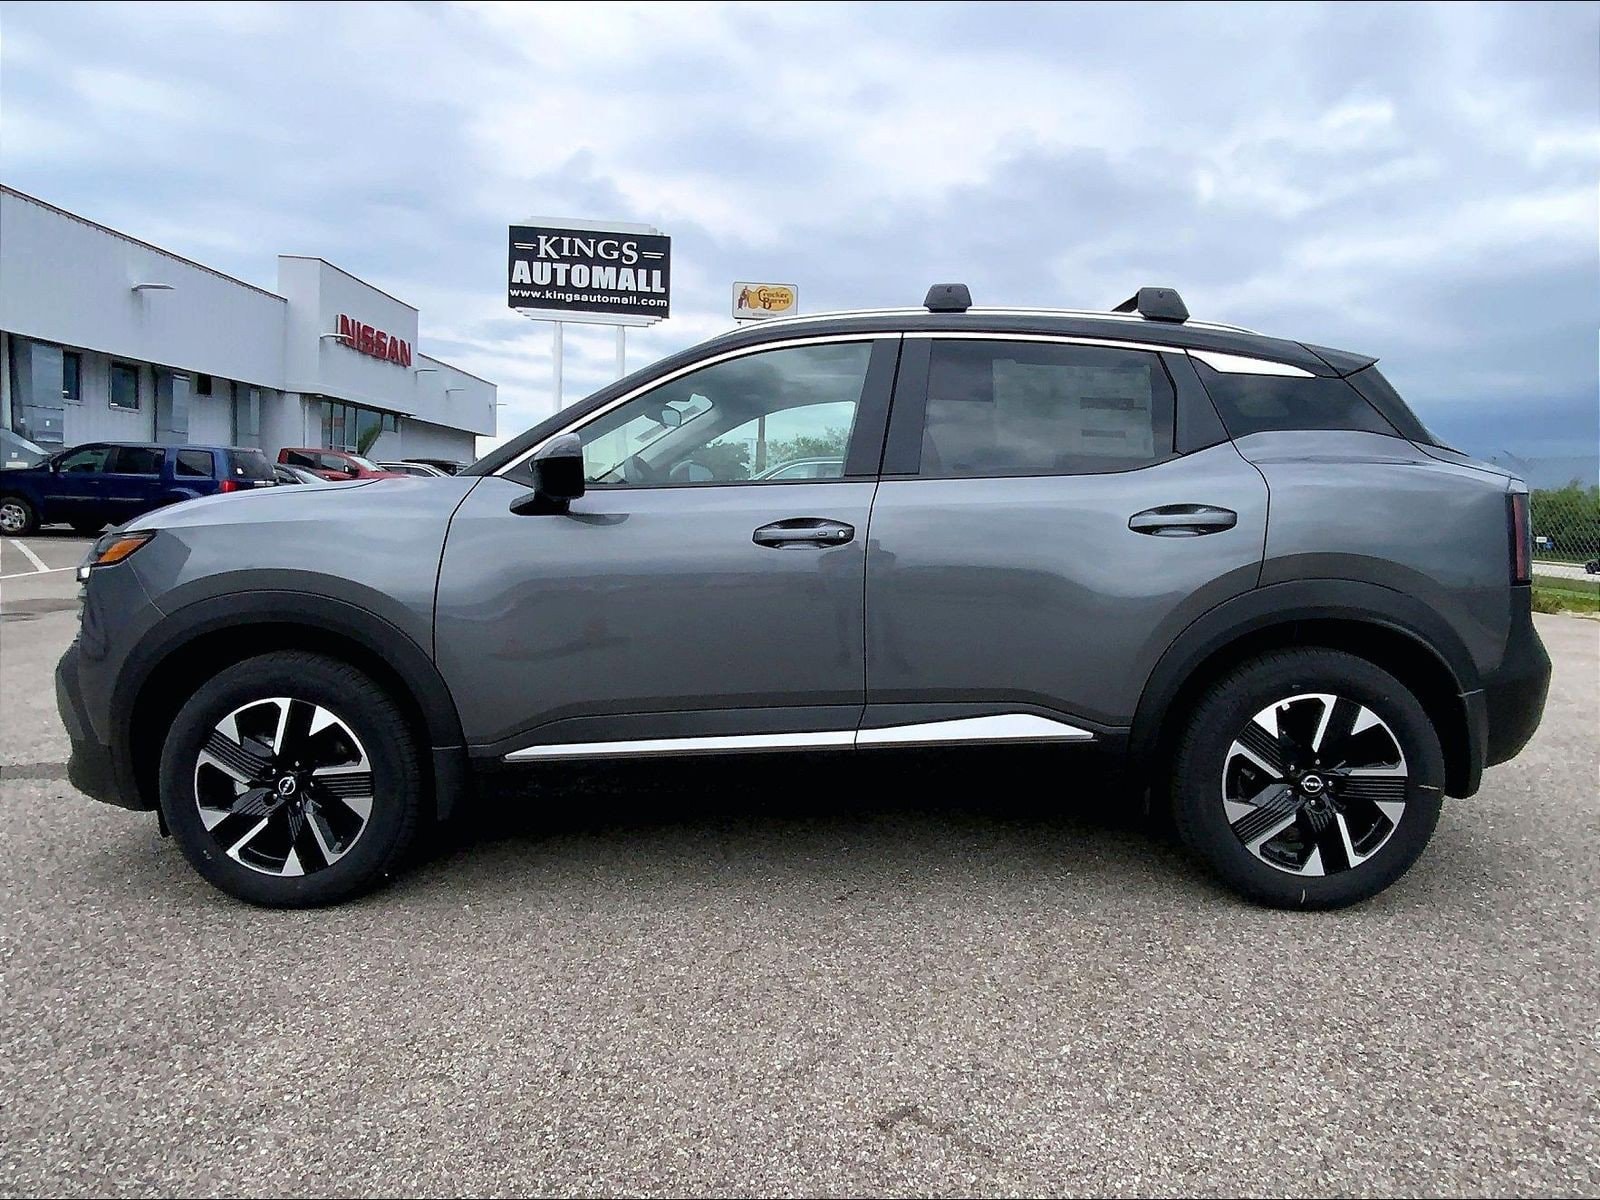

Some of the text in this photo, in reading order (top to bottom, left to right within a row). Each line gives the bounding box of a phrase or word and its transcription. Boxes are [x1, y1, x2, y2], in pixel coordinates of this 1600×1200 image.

[537, 235, 639, 265] KINGS
[511, 260, 666, 293] AUTOMALL
[509, 288, 668, 307] www.kingsautomall.com
[336, 313, 412, 368] NISSAN
